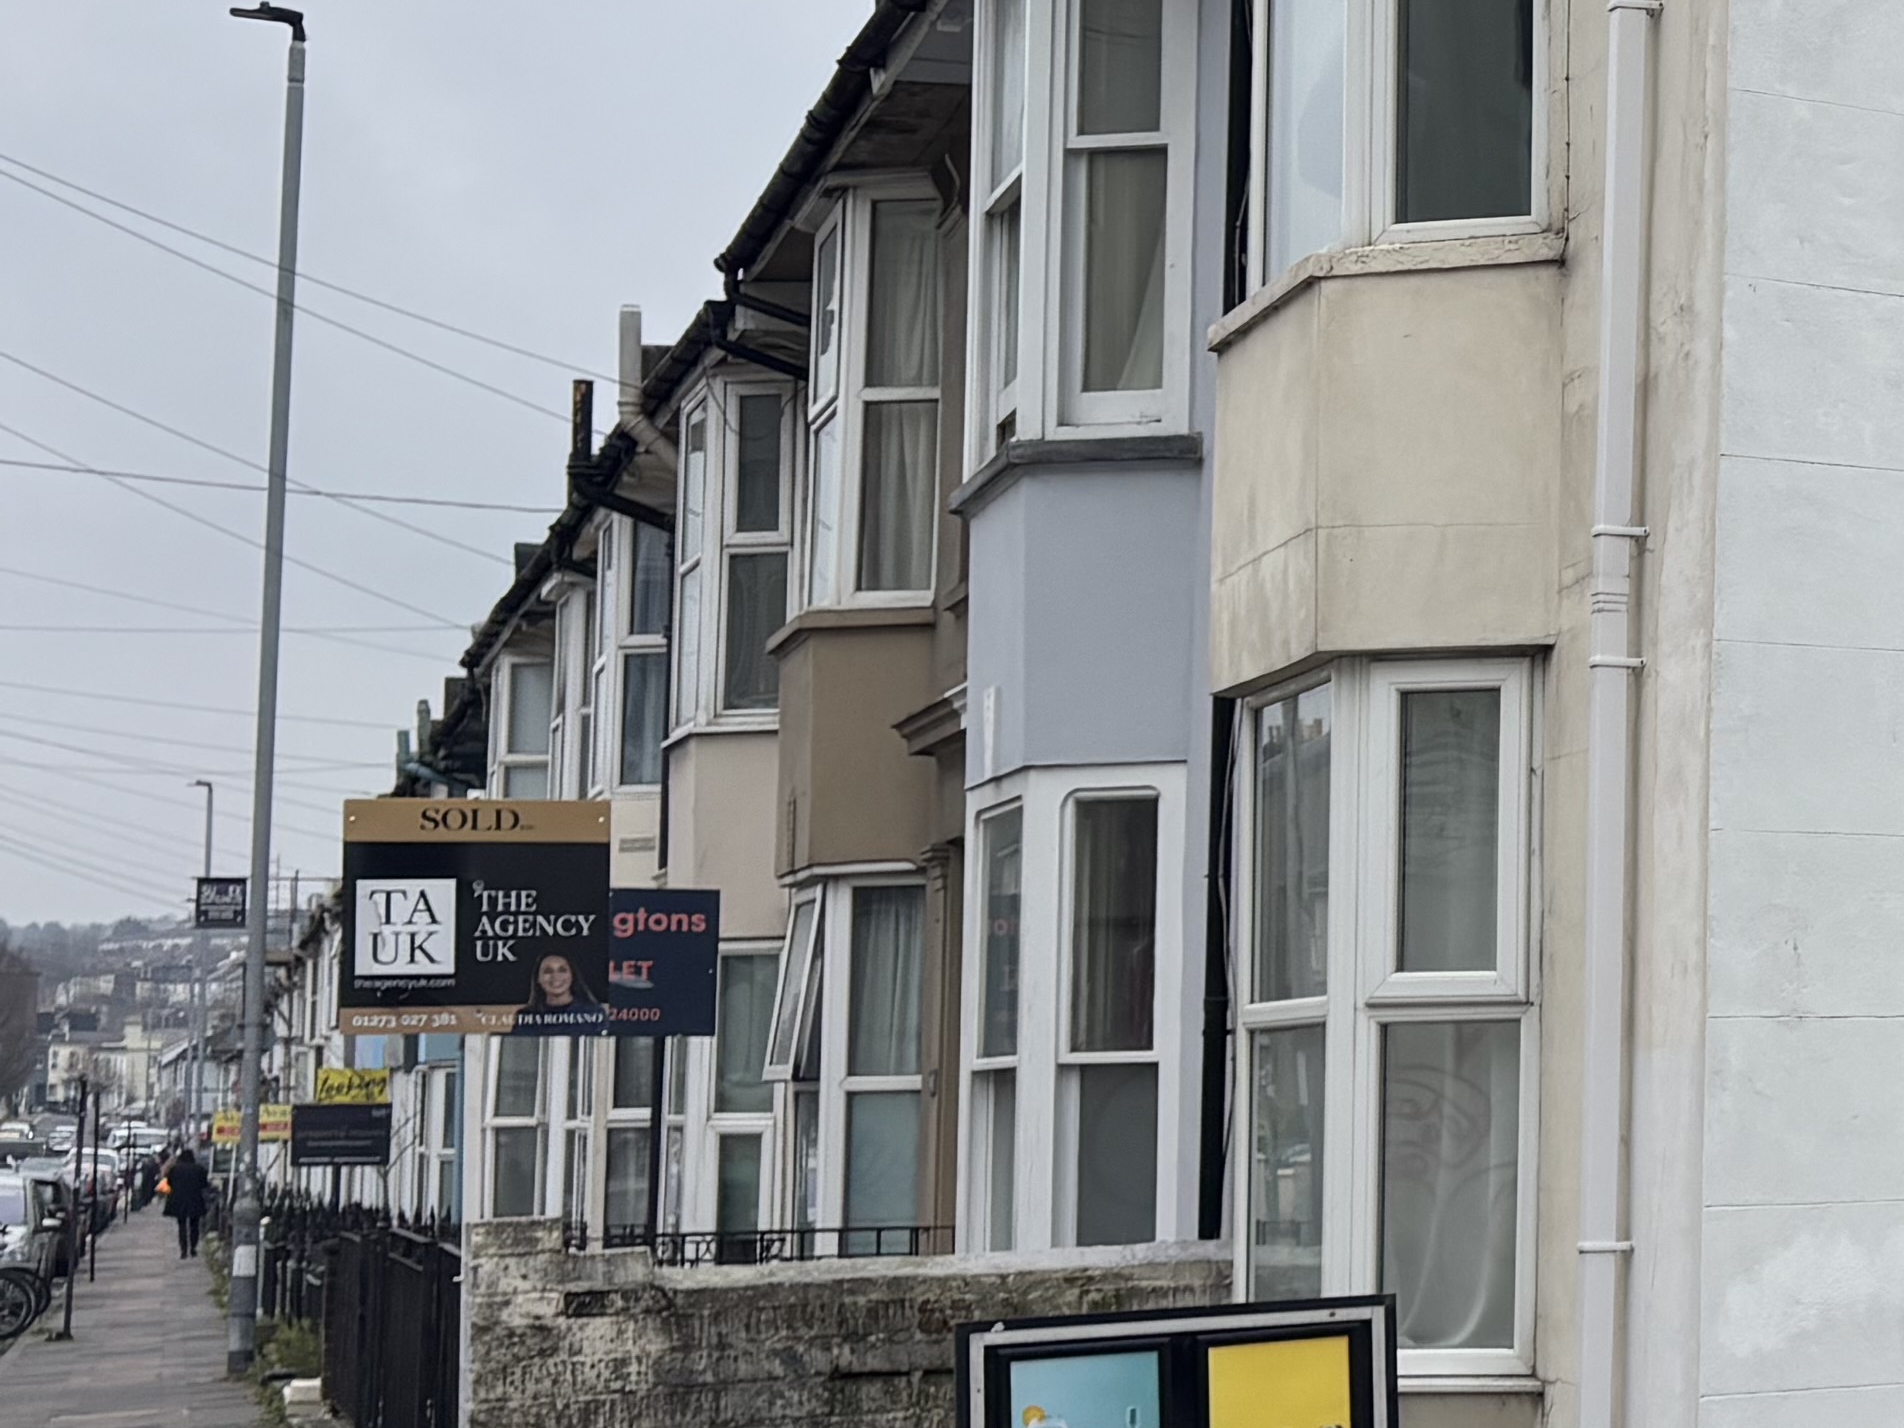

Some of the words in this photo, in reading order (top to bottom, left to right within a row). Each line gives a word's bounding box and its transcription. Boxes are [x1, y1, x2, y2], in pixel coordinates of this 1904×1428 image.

[419, 807, 521, 832] SOLD
[368, 888, 442, 925] TA
[478, 889, 537, 912] THE
[473, 914, 597, 937] AGENCY
[368, 930, 442, 966] UK
[475, 939, 518, 962] UK
[608, 960, 653, 982] LET
[351, 1014, 397, 1028] 01273
[401, 1014, 428, 1027] 027
